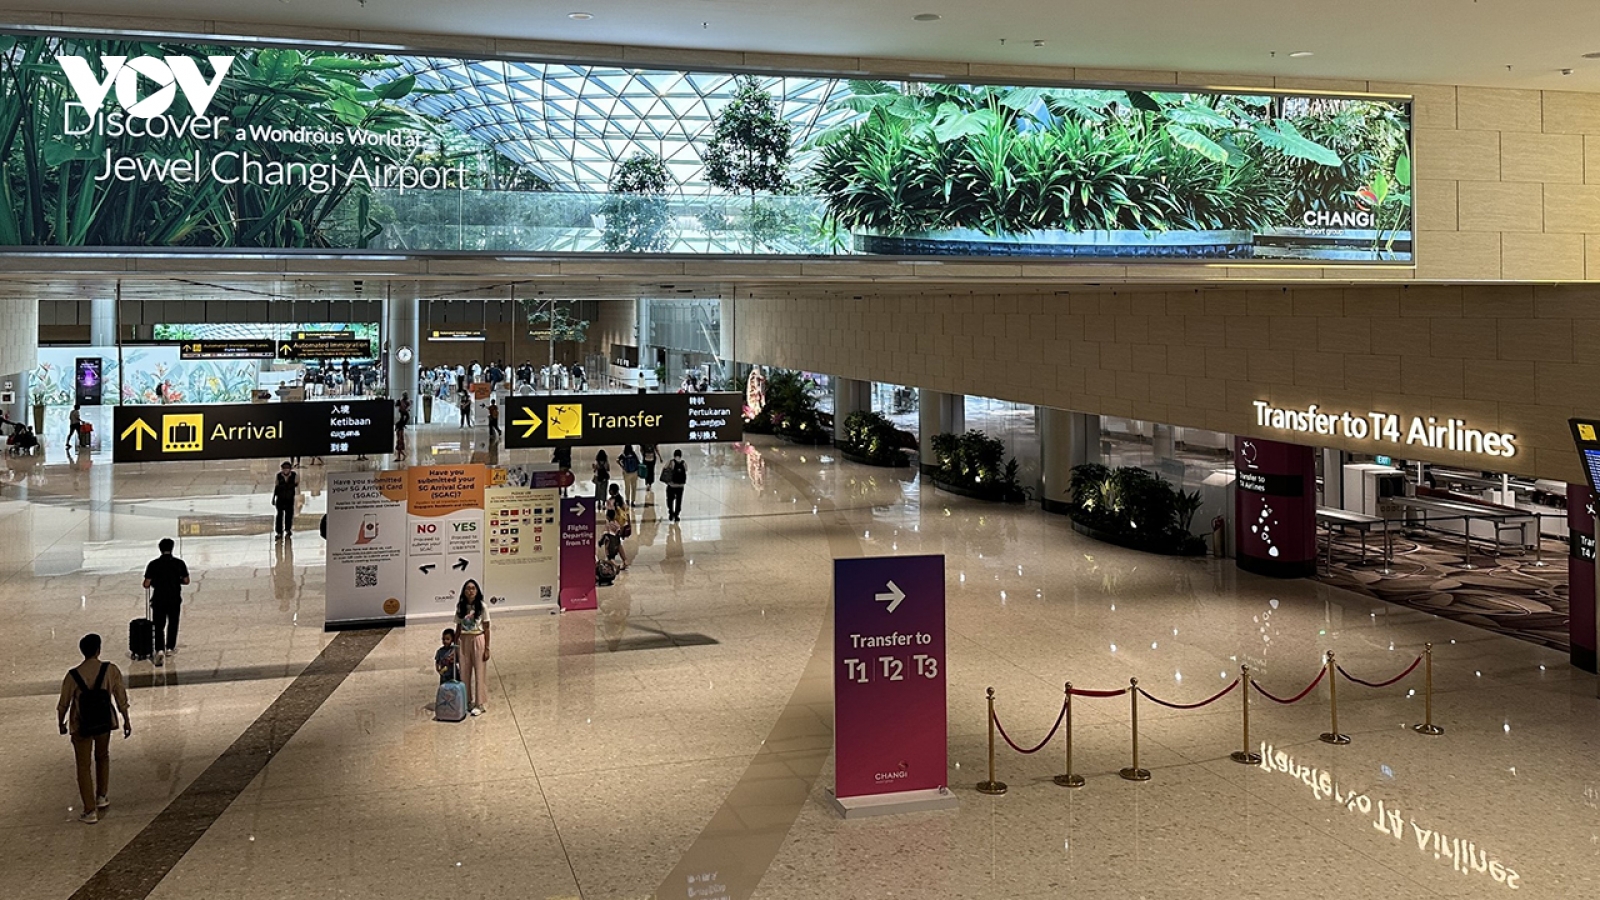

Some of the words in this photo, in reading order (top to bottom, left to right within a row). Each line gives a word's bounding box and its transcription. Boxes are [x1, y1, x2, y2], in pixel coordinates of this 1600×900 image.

[63, 101, 229, 139] Discover
[235, 128, 246, 141] a
[249, 125, 344, 143] Wondrous
[348, 128, 400, 146] World
[94, 148, 200, 183] Jewel
[210, 150, 337, 193] Changi
[345, 156, 470, 195] Airport
[1303, 210, 1375, 227] CHANGI
[689, 407, 731, 416] Pertukaran
[330, 417, 371, 426] Ketibaan
[588, 410, 663, 429] Transfer
[210, 420, 283, 440] Arrival
[1253, 401, 1338, 435] Transfer
[1338, 412, 1368, 438] to
[1369, 412, 1401, 442] T4
[1406, 417, 1516, 457] Airlines
[1377, 455, 1390, 465] EXIT
[367, 476, 402, 484] submitted
[417, 524, 437, 534] NO
[453, 522, 476, 532] YES
[562, 532, 593, 540] Departing
[1580, 535, 1595, 547] Tran
[850, 631, 913, 648] Transfer
[915, 631, 932, 645] to
[844, 659, 869, 683] T1
[879, 656, 904, 681] T2
[913, 654, 938, 679] T3
[874, 771, 908, 780] CHANGI
